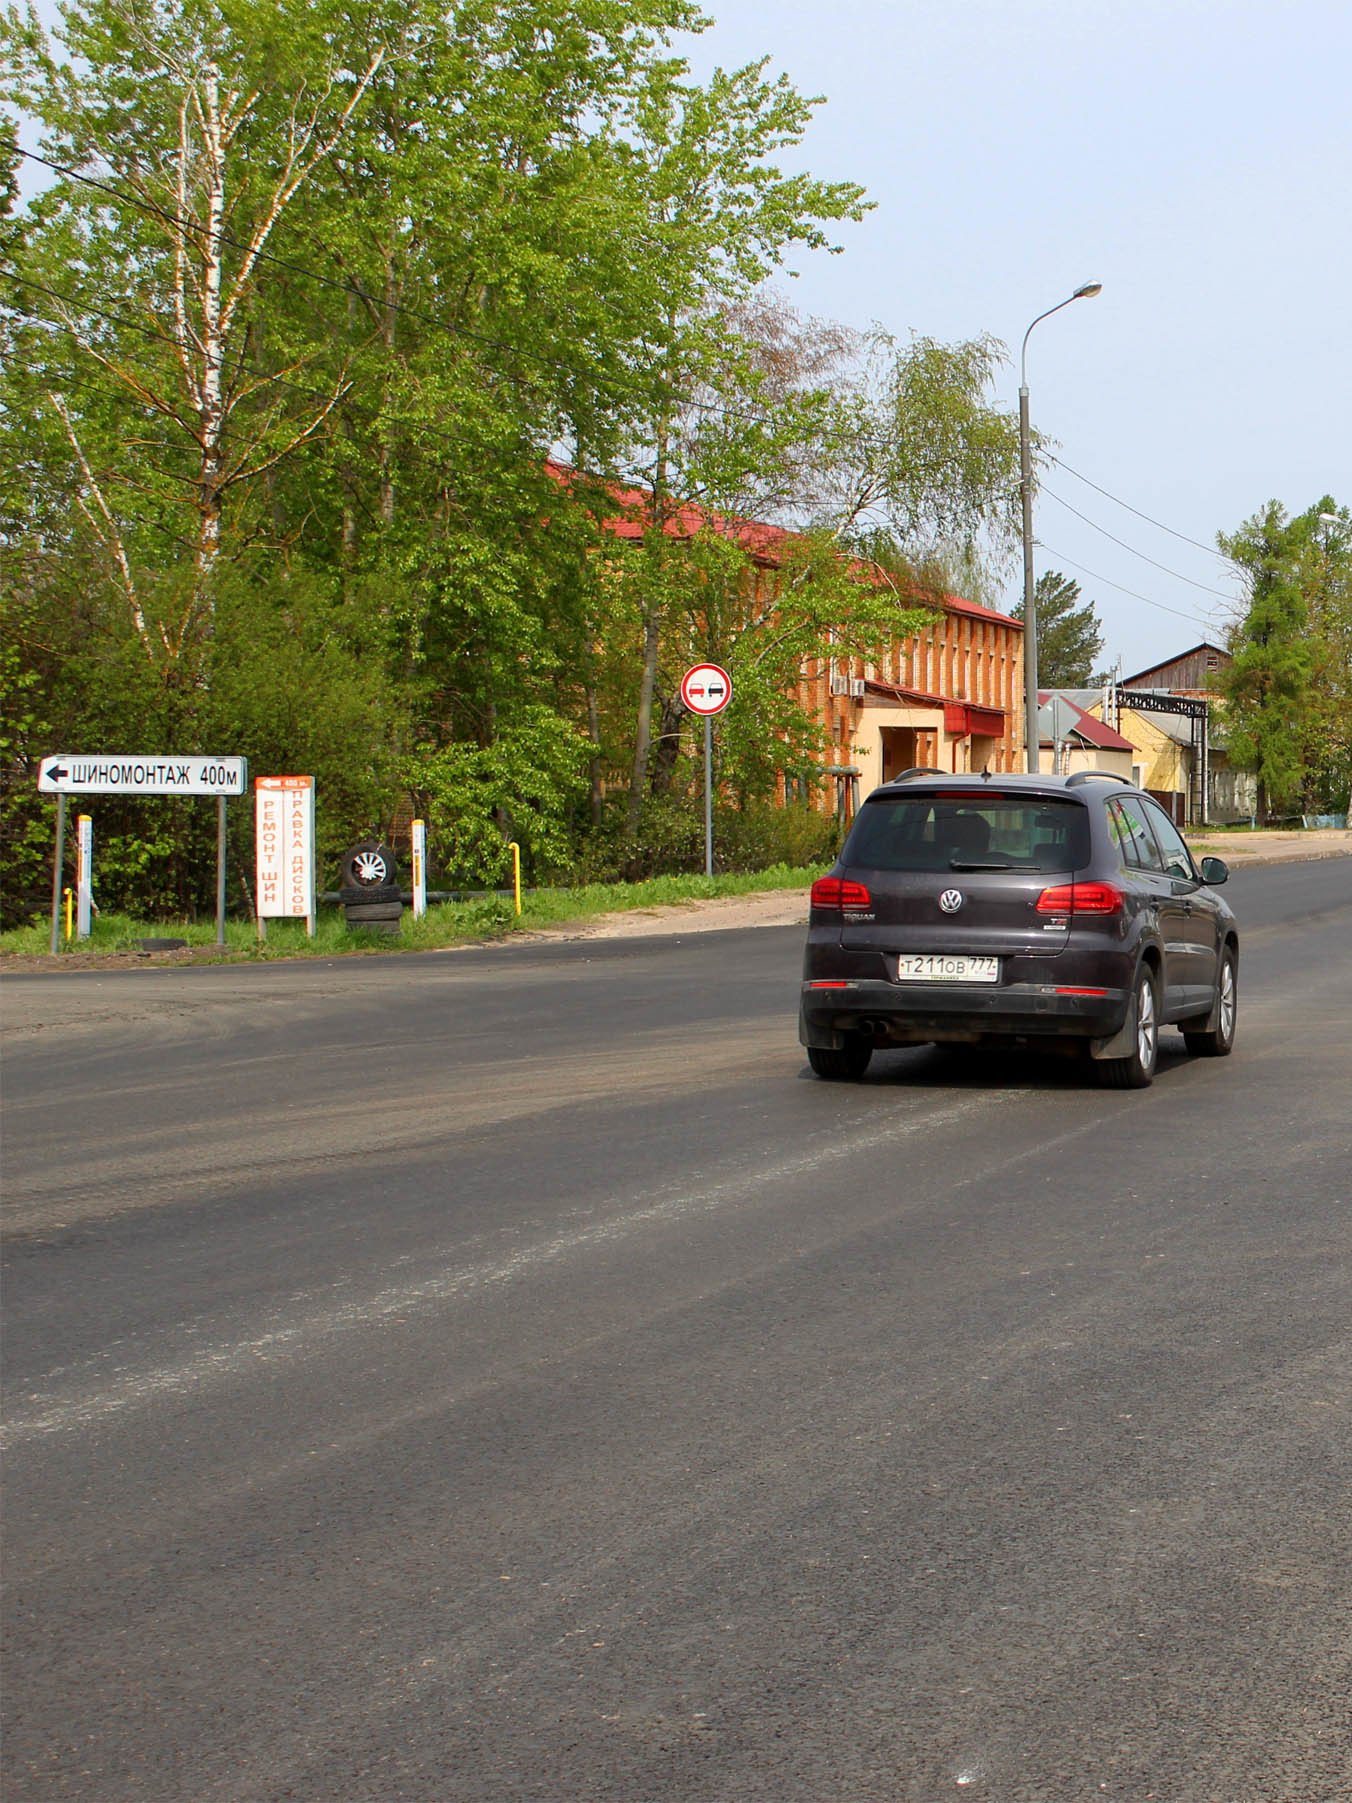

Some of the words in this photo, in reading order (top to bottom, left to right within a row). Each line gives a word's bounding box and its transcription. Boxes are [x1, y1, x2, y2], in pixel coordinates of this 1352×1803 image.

[72, 764, 191, 785] ШИНОМОНТАЖ
[200, 765, 237, 785] 400м
[262, 800, 276, 864] РЕМОНТ
[292, 790, 304, 849] ПРАВКА
[262, 871, 278, 903] ШИН
[292, 855, 304, 914] ДИСКОВ
[905, 957, 966, 974] Т211ОВ
[970, 957, 994, 970] 777
